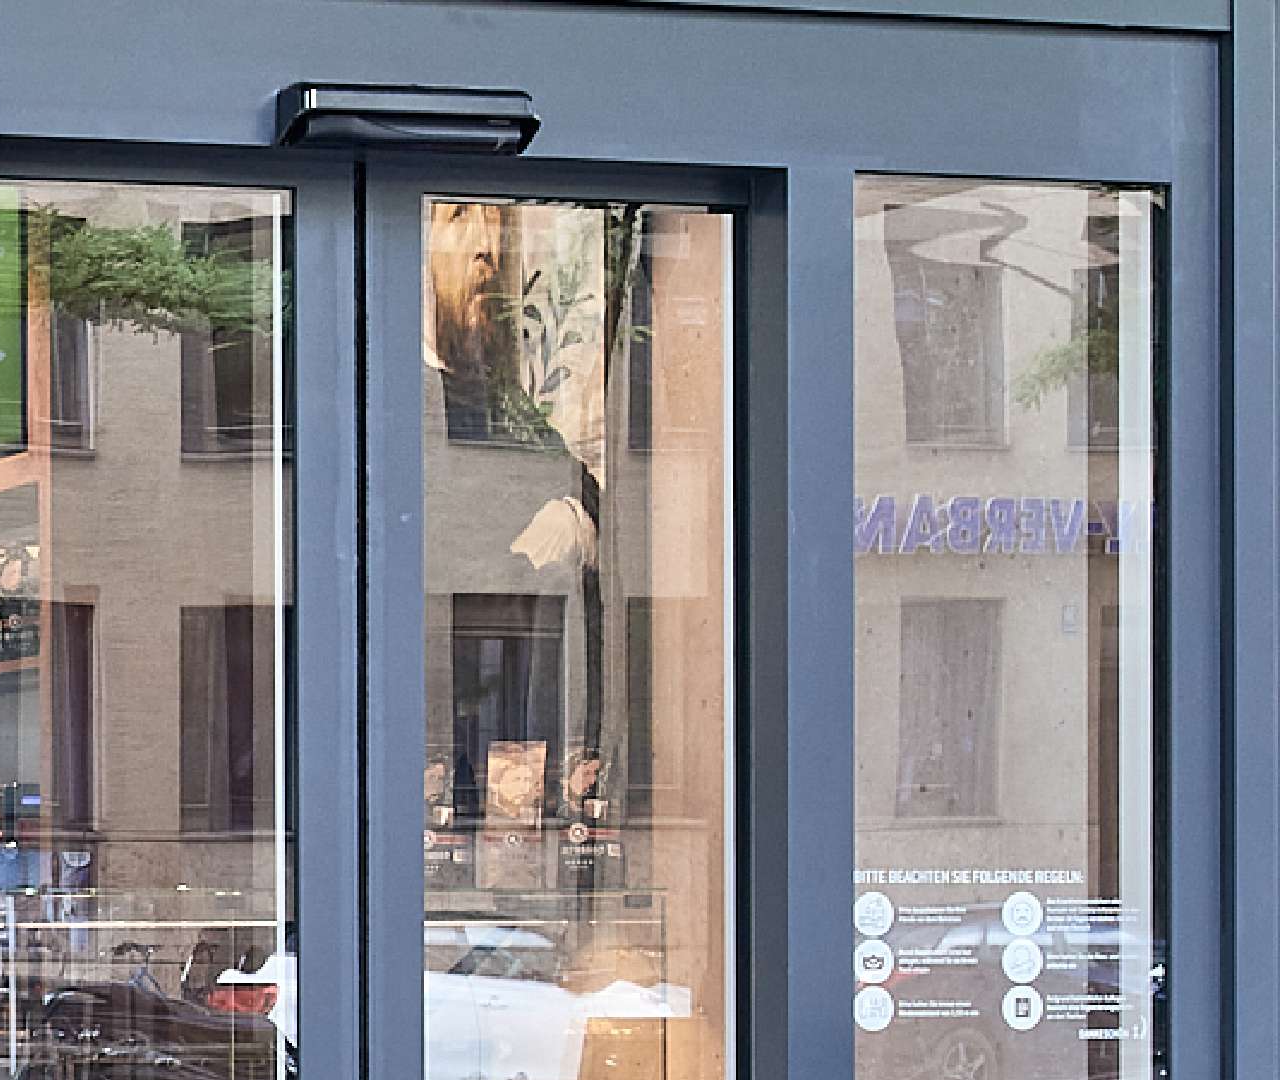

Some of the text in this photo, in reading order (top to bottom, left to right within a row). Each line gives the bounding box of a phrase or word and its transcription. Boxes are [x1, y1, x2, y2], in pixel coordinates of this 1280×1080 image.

[853, 869, 886, 884] BITTE
[888, 869, 950, 884] BEACHTEN
[951, 869, 972, 884] SIE
[972, 869, 1034, 884] FOLGENDE
